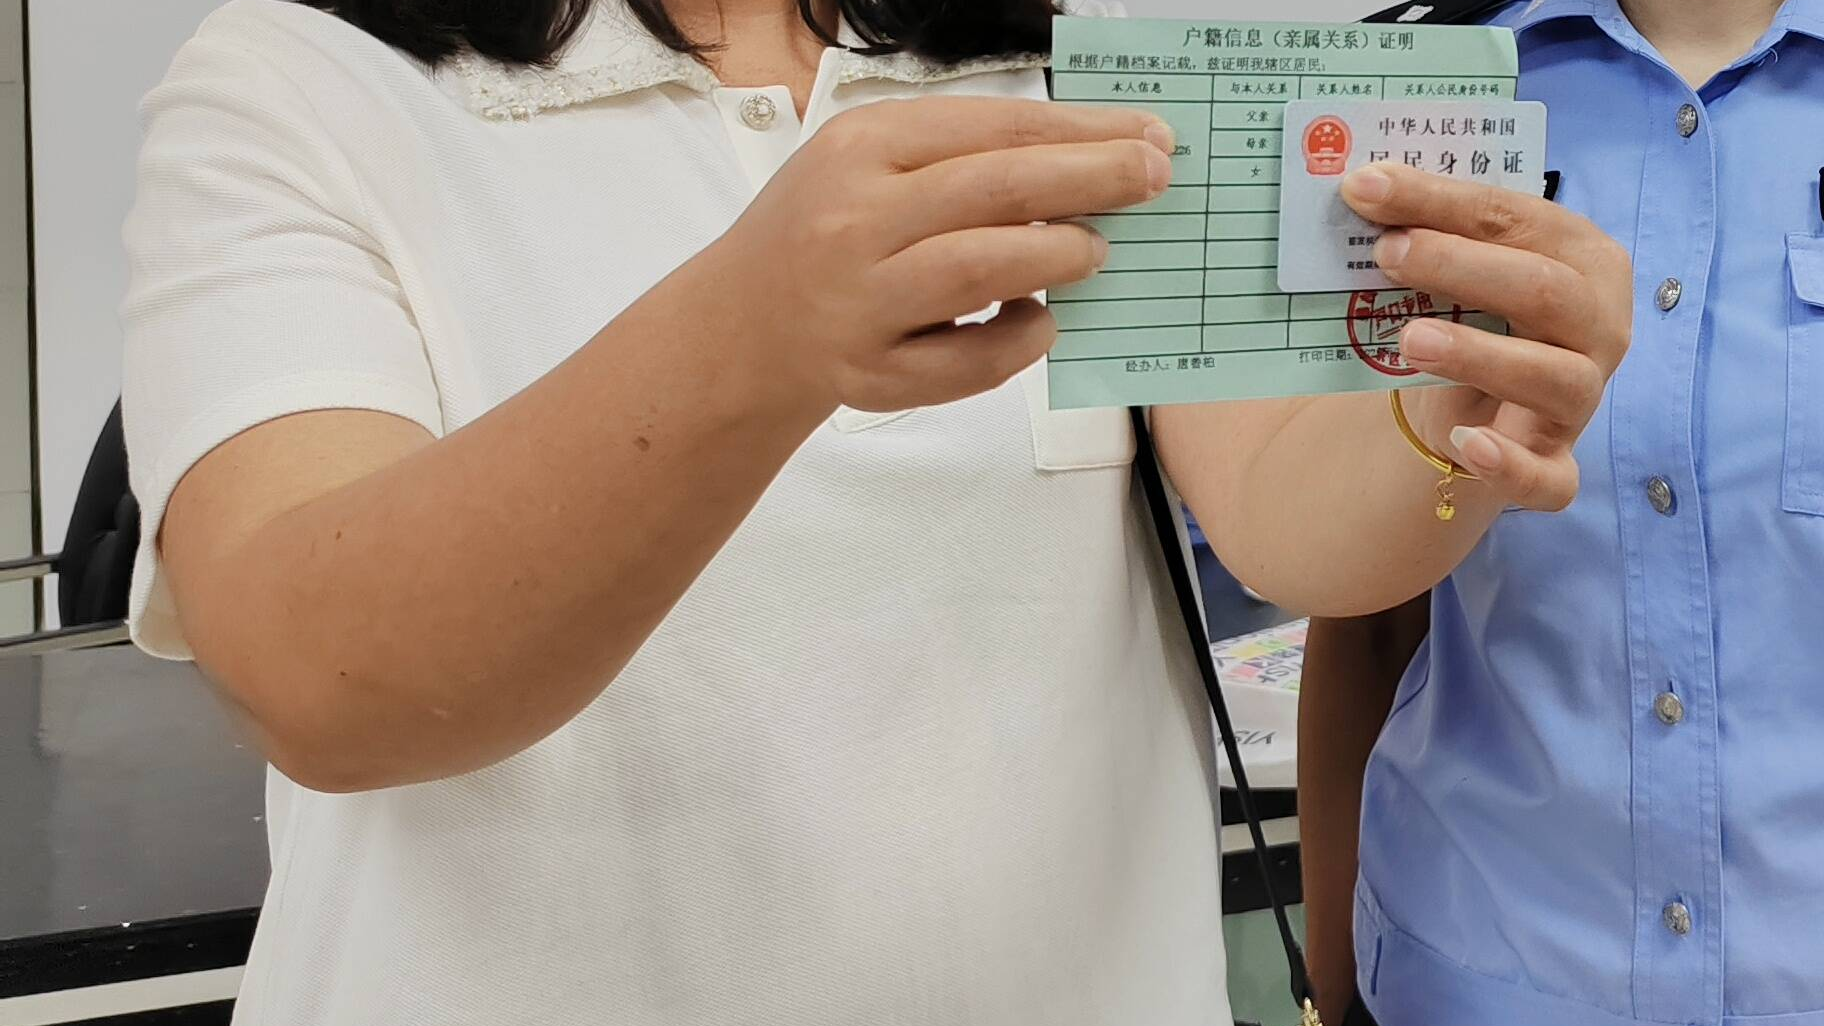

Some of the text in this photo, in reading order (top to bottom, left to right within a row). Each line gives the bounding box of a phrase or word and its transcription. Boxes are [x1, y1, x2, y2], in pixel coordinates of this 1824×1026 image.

[1182, 26, 1415, 51] 户籍信息（亲属关系）证明
[1111, 80, 1163, 94] 本人信息
[1229, 81, 1288, 96] 与本人关系
[1316, 82, 1373, 97] 关系人姓名
[1404, 83, 1500, 98] 关系人公民身份号码
[1378, 117, 1516, 137] 中华人民共和国
[1250, 165, 1262, 178] 女
